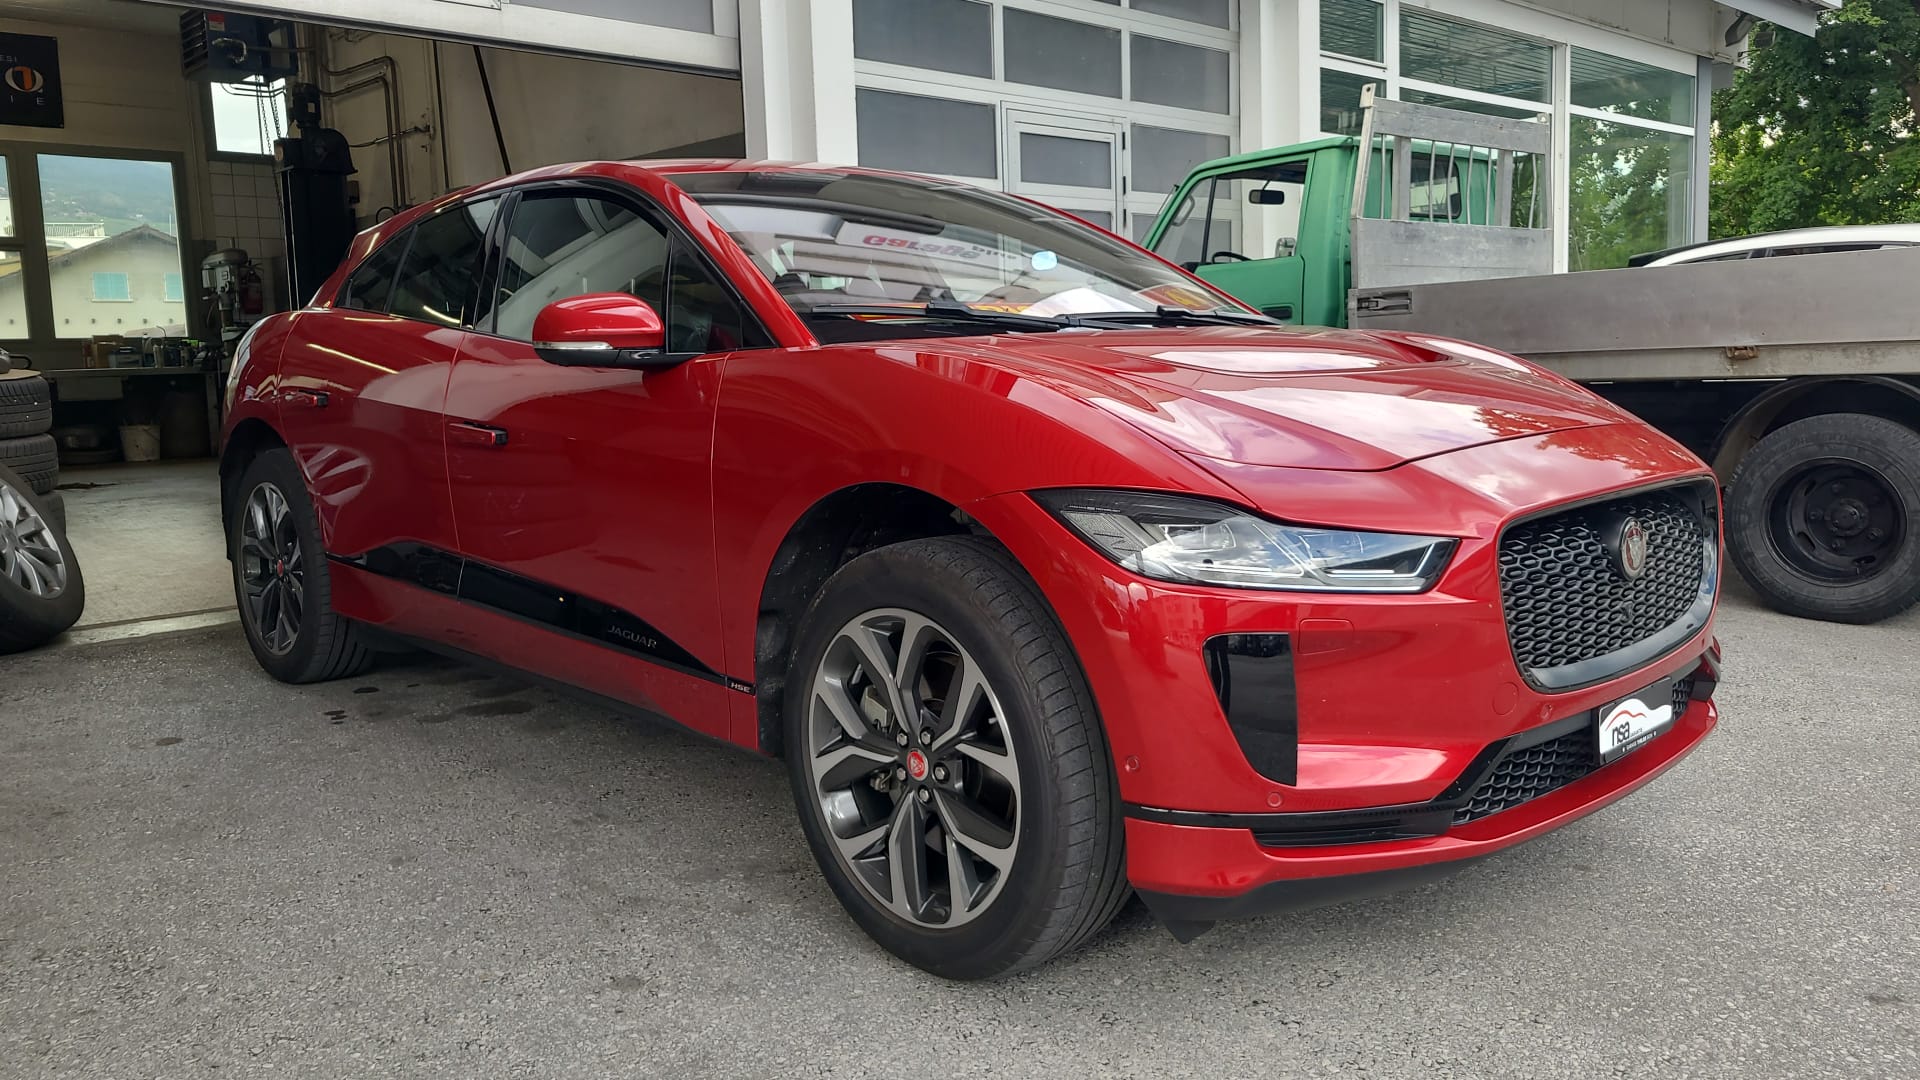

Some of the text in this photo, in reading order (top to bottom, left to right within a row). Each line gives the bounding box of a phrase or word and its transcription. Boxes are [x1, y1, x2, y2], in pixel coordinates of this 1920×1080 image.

[607, 624, 657, 649] JAGUAR
[730, 681, 751, 693] HSE
[1611, 720, 1630, 747] nsa
